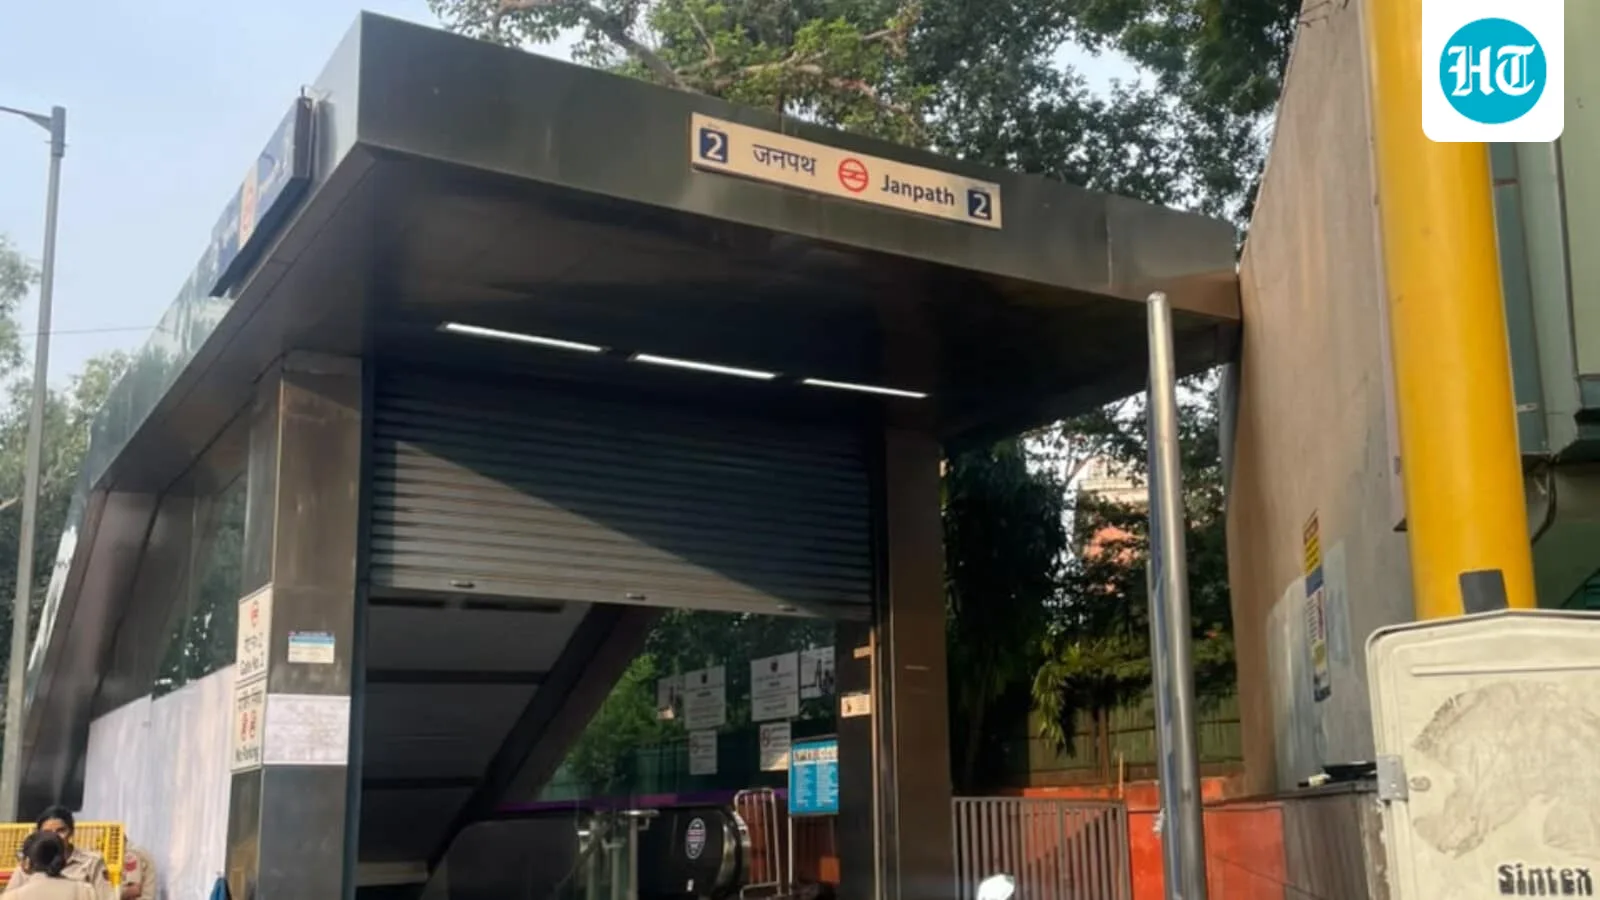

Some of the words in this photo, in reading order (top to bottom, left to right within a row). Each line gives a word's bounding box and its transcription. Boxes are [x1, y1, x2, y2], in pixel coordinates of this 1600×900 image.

[705, 132, 723, 161] 2
[752, 144, 816, 176] जनपथ
[881, 174, 955, 206] Janpath
[973, 192, 988, 218] 2
[1498, 862, 1593, 896] Sintex
